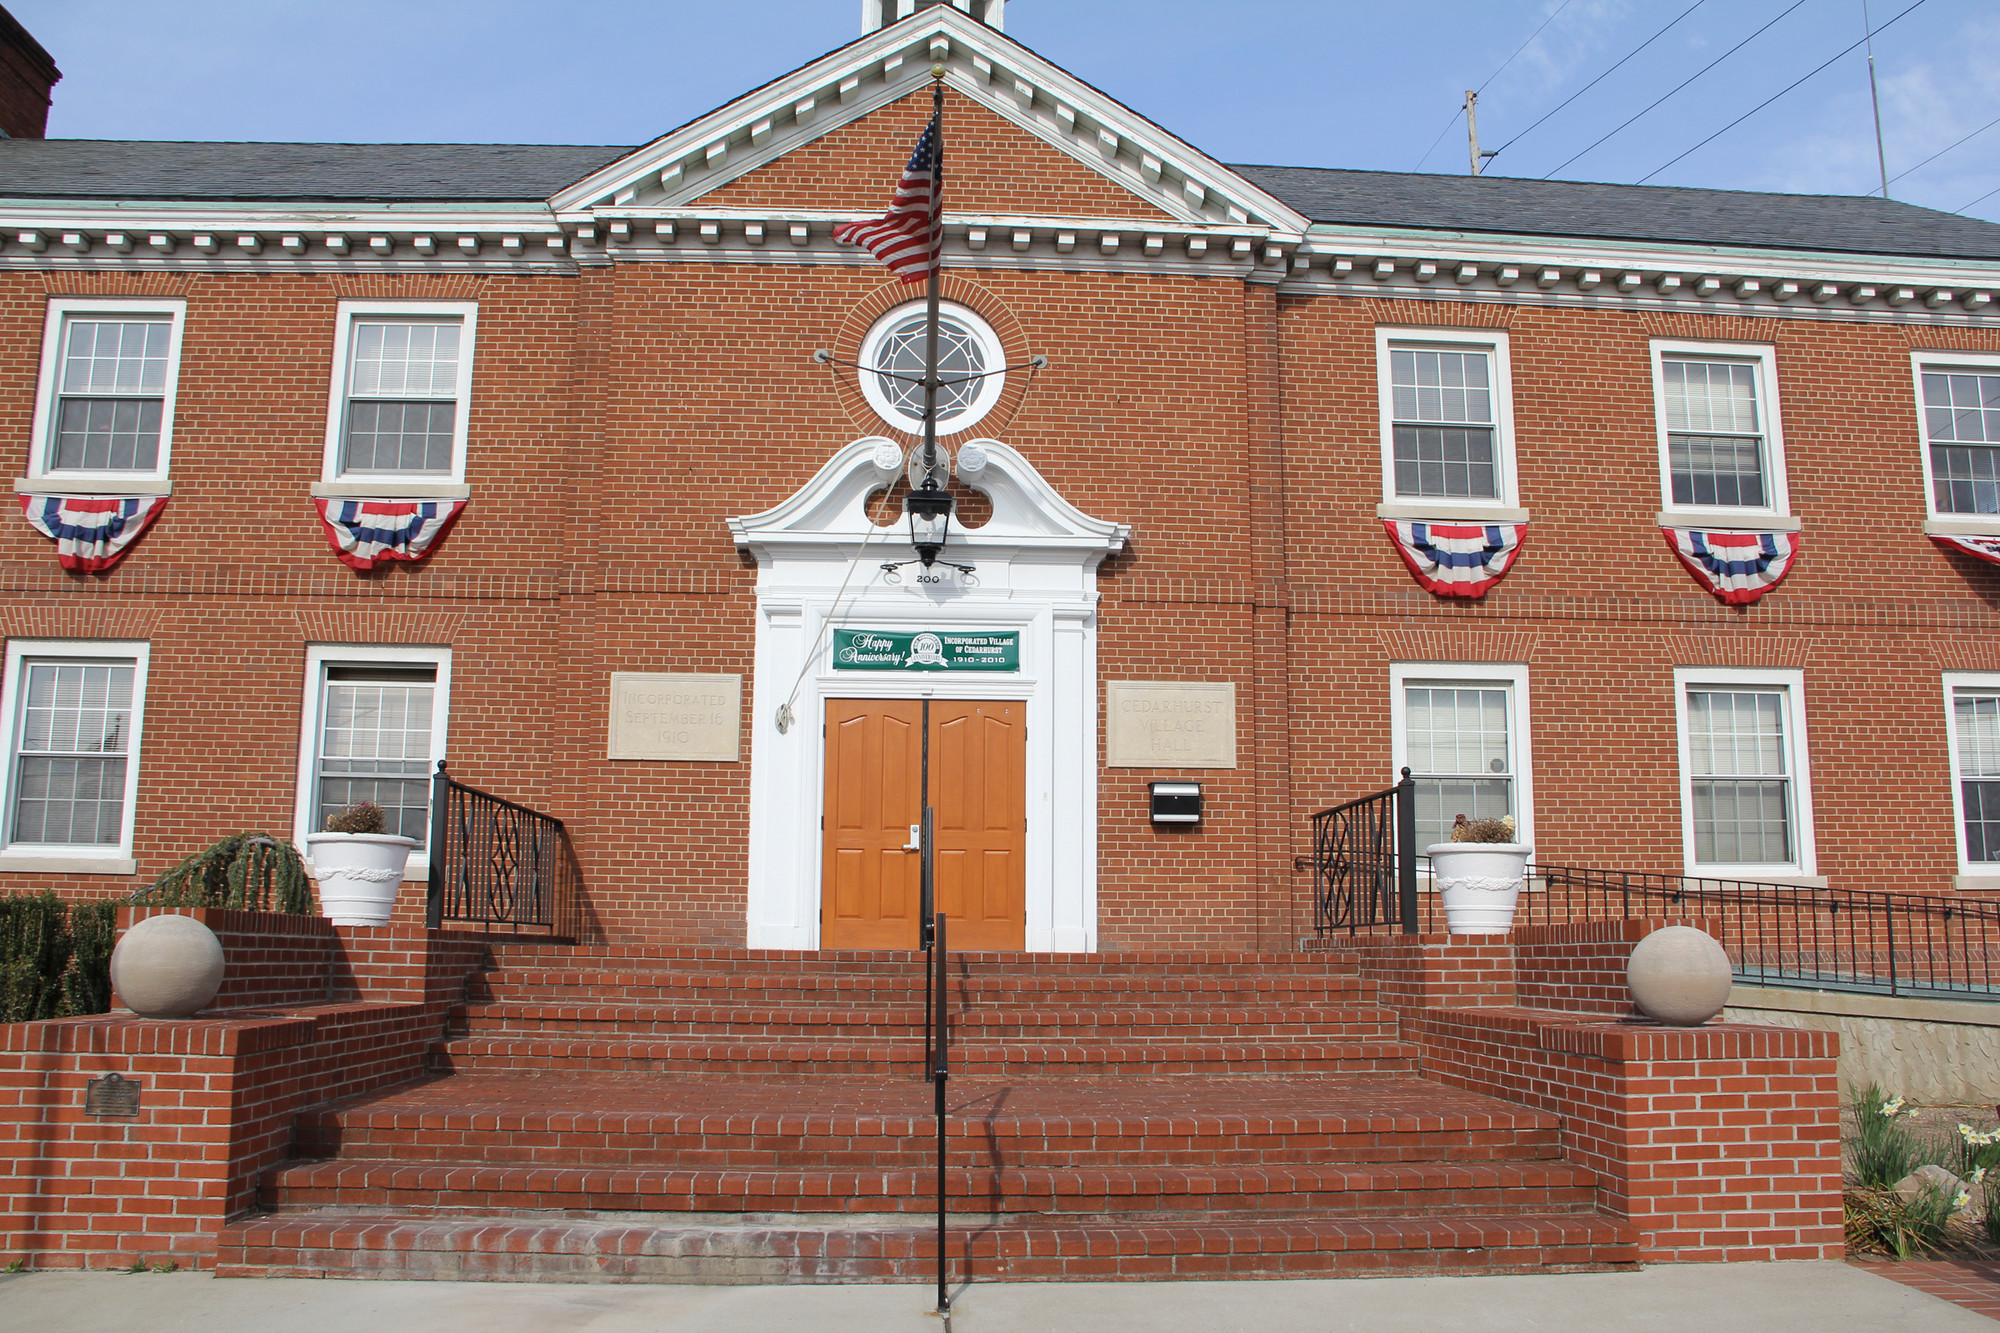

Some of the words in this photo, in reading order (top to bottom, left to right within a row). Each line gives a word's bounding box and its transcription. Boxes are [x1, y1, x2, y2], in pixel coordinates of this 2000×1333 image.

[917, 575, 940, 584] 200
[852, 633, 893, 652] Happy
[919, 642, 935, 652] 100
[944, 636, 988, 645] INCORPORATED
[988, 637, 1014, 646] VILLAGE
[839, 646, 906, 666] Anniversary!
[964, 645, 1003, 654] CEDARHURST
[624, 691, 727, 706] INCORPORATED
[1121, 699, 1222, 714] CEDARHURST
[625, 710, 706, 725] SEPTEMBER
[710, 712, 724, 726] 16
[1139, 719, 1205, 733] VILLAGE
[657, 730, 690, 744] 1910
[1151, 738, 1192, 752] HALL
